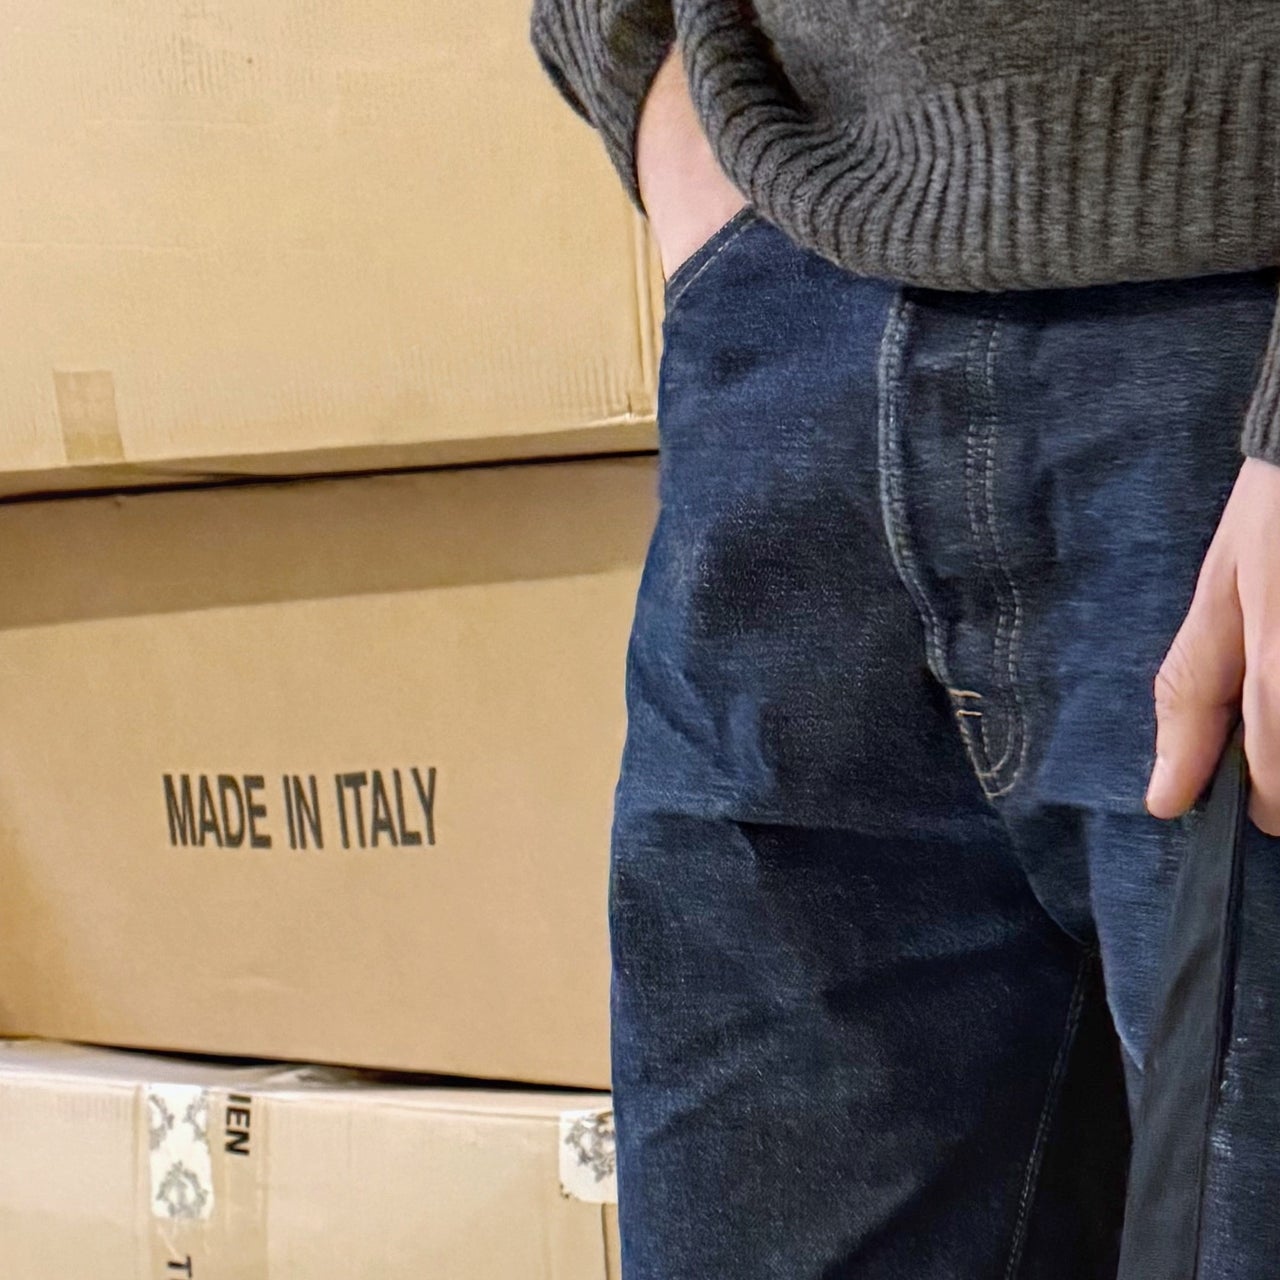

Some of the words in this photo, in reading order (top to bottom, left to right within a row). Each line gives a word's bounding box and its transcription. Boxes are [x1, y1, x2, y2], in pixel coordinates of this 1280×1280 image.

[162, 773, 272, 850] MADE
[282, 773, 324, 850] IN
[334, 766, 437, 850] ITALY
